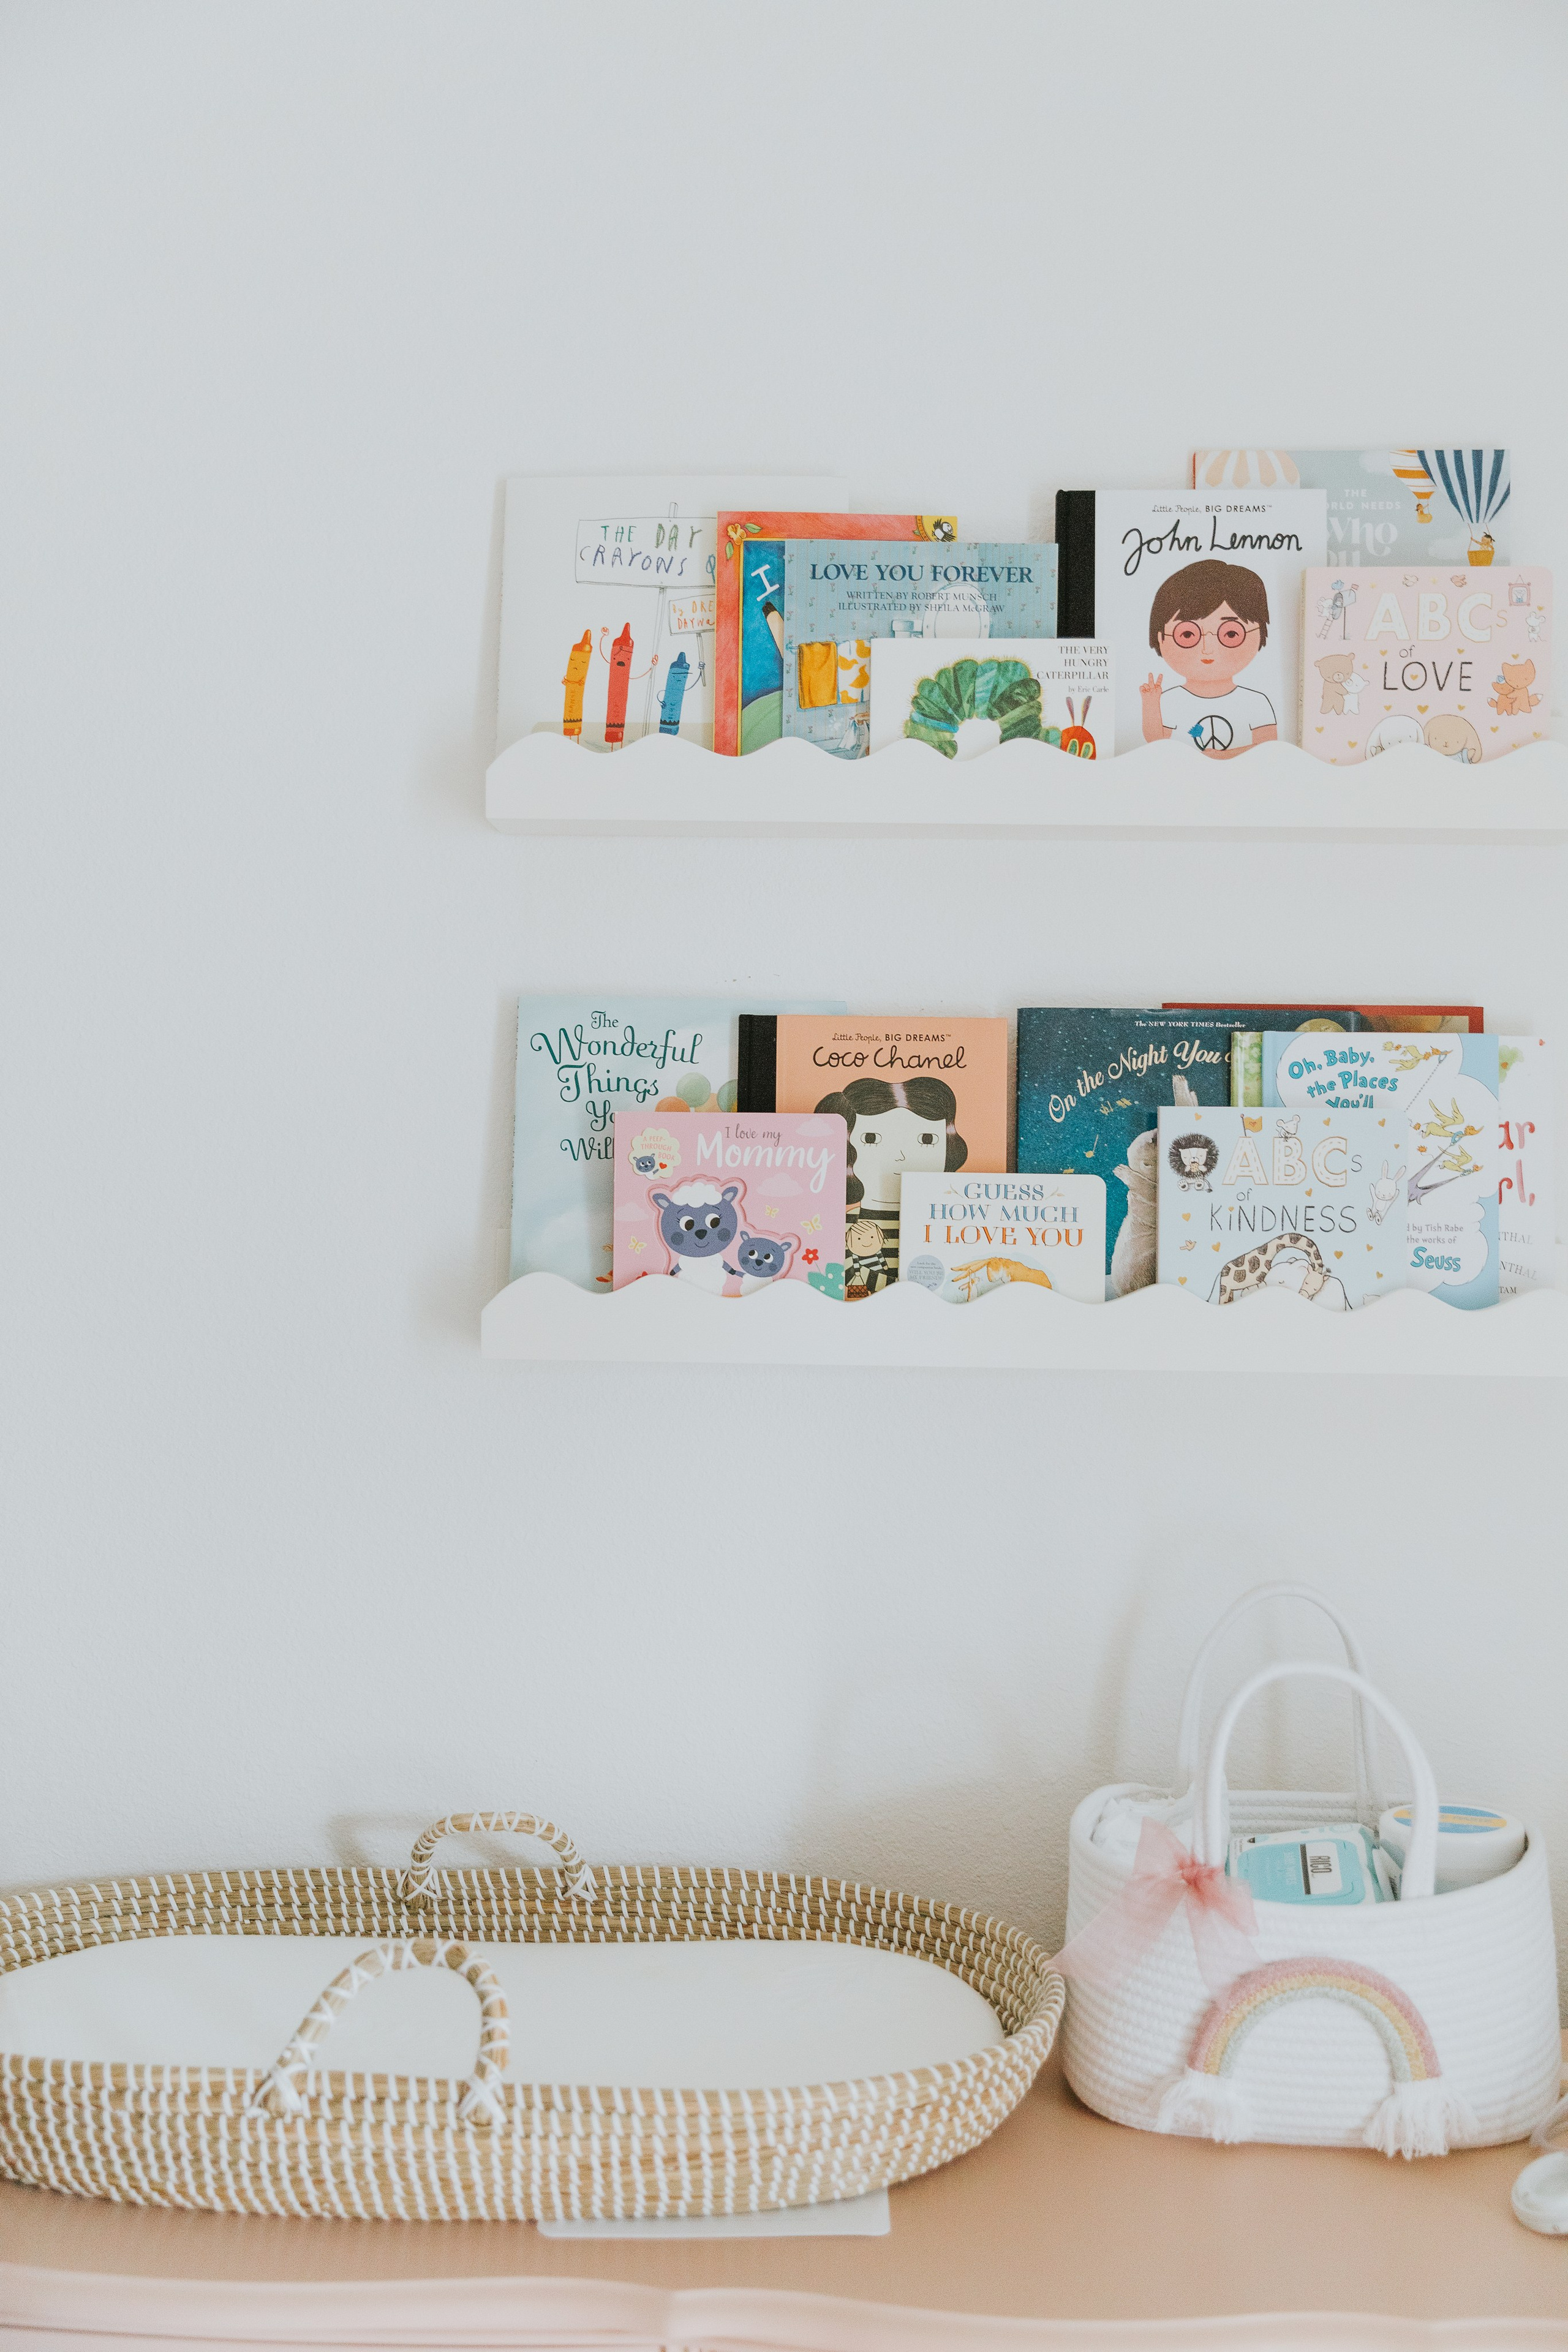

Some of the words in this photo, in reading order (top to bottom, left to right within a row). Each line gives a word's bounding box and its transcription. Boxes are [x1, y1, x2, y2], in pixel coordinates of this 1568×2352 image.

[1362, 501, 1401, 510] NEEDS
[601, 526, 636, 543] THE
[655, 523, 703, 551] DAY
[1121, 519, 1202, 576] John
[1210, 515, 1302, 551] Lennon
[580, 544, 688, 576] CRAYONS
[751, 564, 780, 601] I
[810, 564, 869, 581] LOVE
[875, 565, 925, 582] YOU
[932, 565, 1034, 582] FOREVER
[846, 590, 897, 600] WRITTEN
[953, 592, 997, 601] MUNSCH
[839, 602, 907, 611] ILLUSTRATED
[924, 603, 959, 612] SHEILA
[1364, 592, 1508, 643] ABCs
[1058, 646, 1080, 654] THE
[1083, 646, 1109, 654] VERY
[1399, 645, 1415, 658] of
[1065, 658, 1109, 667] HUNGRY
[1384, 662, 1472, 691] LOVE
[1068, 685, 1075, 694] by
[591, 1011, 619, 1029] The
[530, 1025, 703, 1069] Wonderful
[832, 1033, 853, 1041] Little
[855, 1033, 881, 1044] People,
[813, 1046, 869, 1067] Coco
[873, 1045, 967, 1069] Chanel
[1324, 1047, 1374, 1067] Baby,
[557, 1061, 659, 1103] Things
[1049, 1093, 1076, 1123] On
[1076, 1070, 1104, 1097] the
[1108, 1044, 1168, 1077] Night
[1173, 1040, 1222, 1069] You
[1307, 1080, 1336, 1098] the
[1338, 1070, 1398, 1091] Places
[725, 1126, 730, 1138] I
[735, 1123, 758, 1139] love
[763, 1130, 783, 1147] my
[641, 1143, 672, 1152] THROUGH
[658, 1152, 676, 1161] BOOK
[696, 1131, 835, 1194] Mommy
[1222, 1136, 1362, 1187] ABCs
[964, 1182, 1044, 1200] GUESS
[1237, 1188, 1252, 1201] of
[929, 1204, 991, 1221] HOW
[1000, 1205, 1079, 1223] MUCH
[923, 1224, 932, 1244] I
[944, 1225, 1017, 1246] LOVE
[1025, 1226, 1085, 1247] YOU
[1412, 1224, 1422, 1234] by
[1406, 1235, 1419, 1243] the
[1422, 1235, 1446, 1244] works
[1448, 1235, 1457, 1244] of
[1410, 1246, 1461, 1272] Seuss
[1310, 1856, 1332, 1874] RICO
